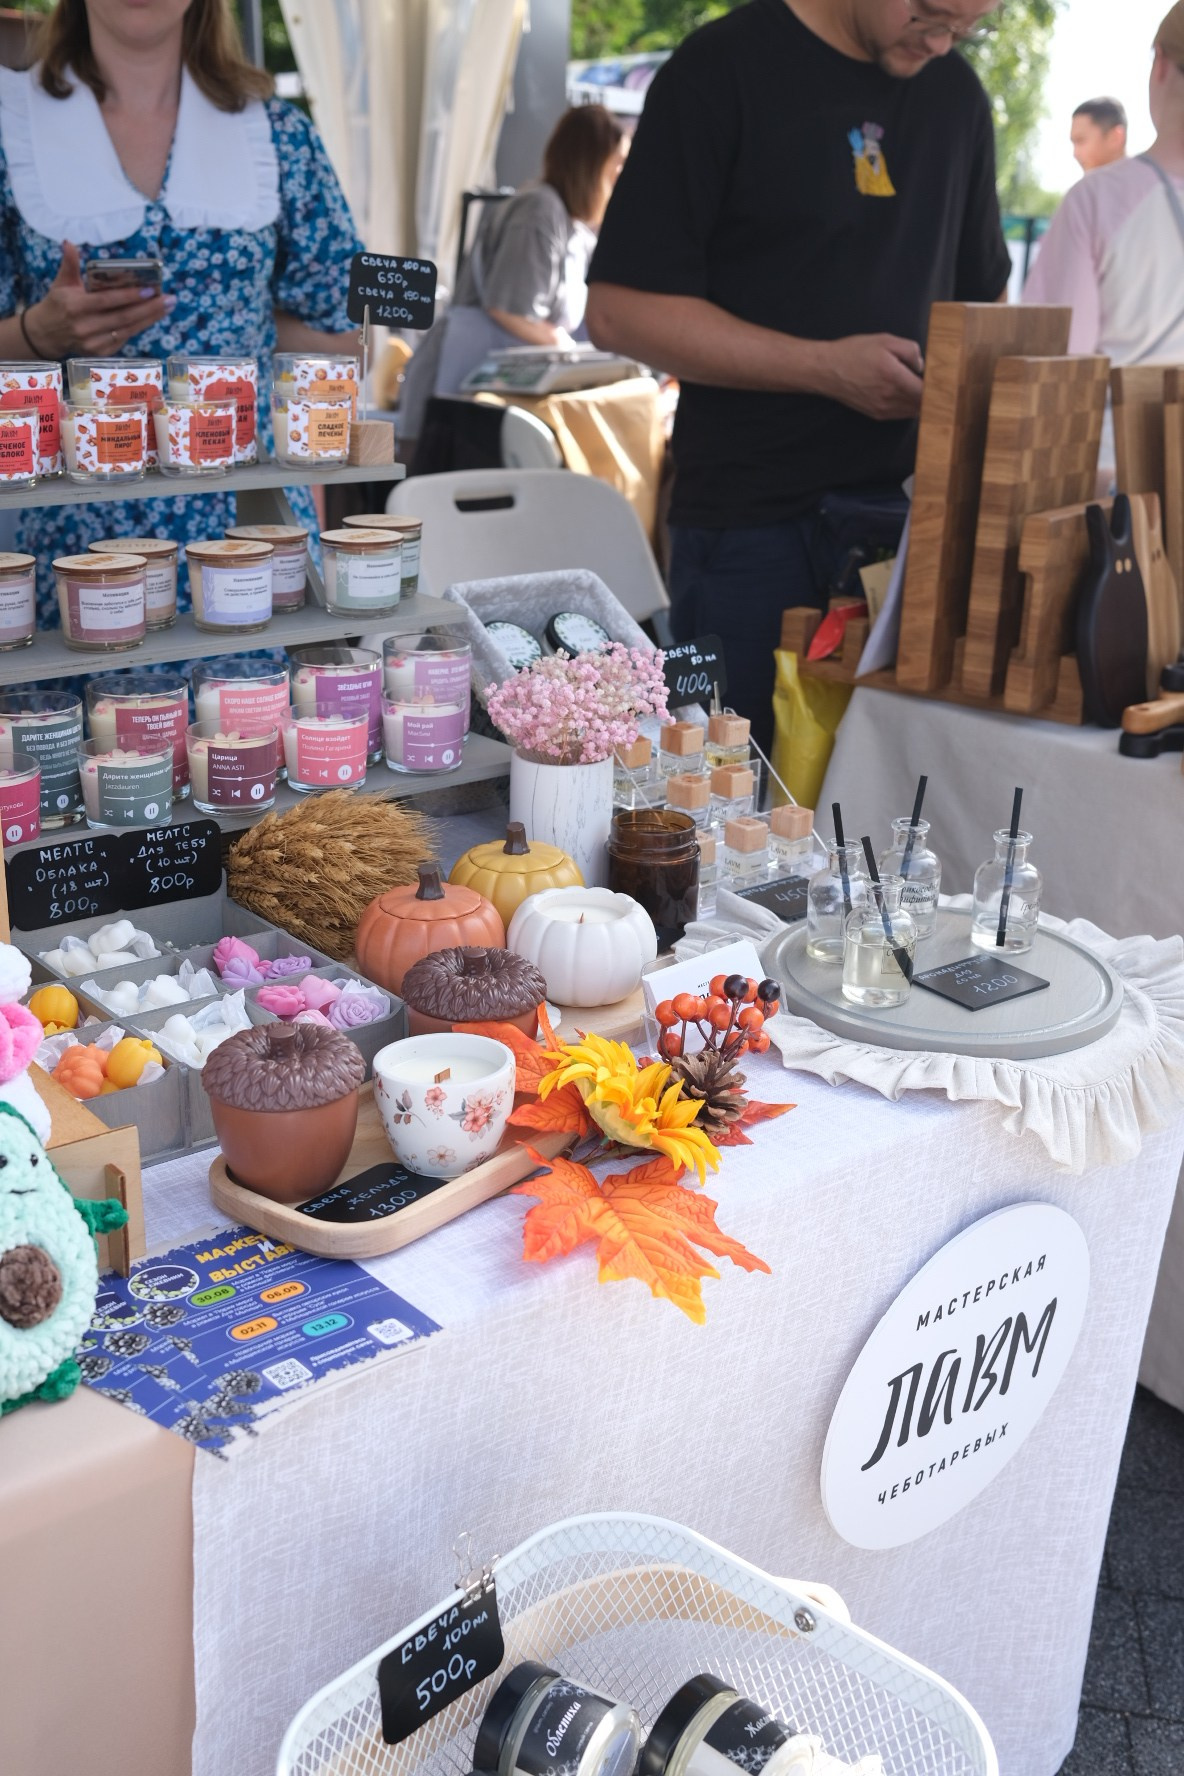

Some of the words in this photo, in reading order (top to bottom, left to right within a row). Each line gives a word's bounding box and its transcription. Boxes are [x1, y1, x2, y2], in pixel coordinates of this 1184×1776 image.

[361, 256, 397, 268] СВЕЧА
[357, 286, 394, 299] СВЕЧА
[0, 441, 26, 450] ЕЧЕНОЕ
[114, 441, 133, 449] ПИРОГ
[212, 753, 238, 762] Царица
[725, 858, 740, 869] LAVM
[973, 974, 1018, 994] 1200
[303, 1188, 352, 1213] СВЕЧА
[369, 1190, 417, 1217] 1300
[195, 1234, 268, 1264] МАРКЕТ
[257, 1240, 276, 1253] И
[208, 1242, 295, 1283] ВЫСТАВК
[197, 1288, 230, 1303] 30.08
[267, 1285, 298, 1299] 06.09
[916, 1254, 1047, 1332] МАСТЕРСКАЯ
[240, 1321, 267, 1335] 02.11
[877, 1422, 1009, 1505] ЧЕБОТАРЕВЫХ
[401, 1607, 459, 1664] СВЕЧА
[416, 1654, 477, 1711] 500р
[546, 1701, 582, 1757] Облепиха
